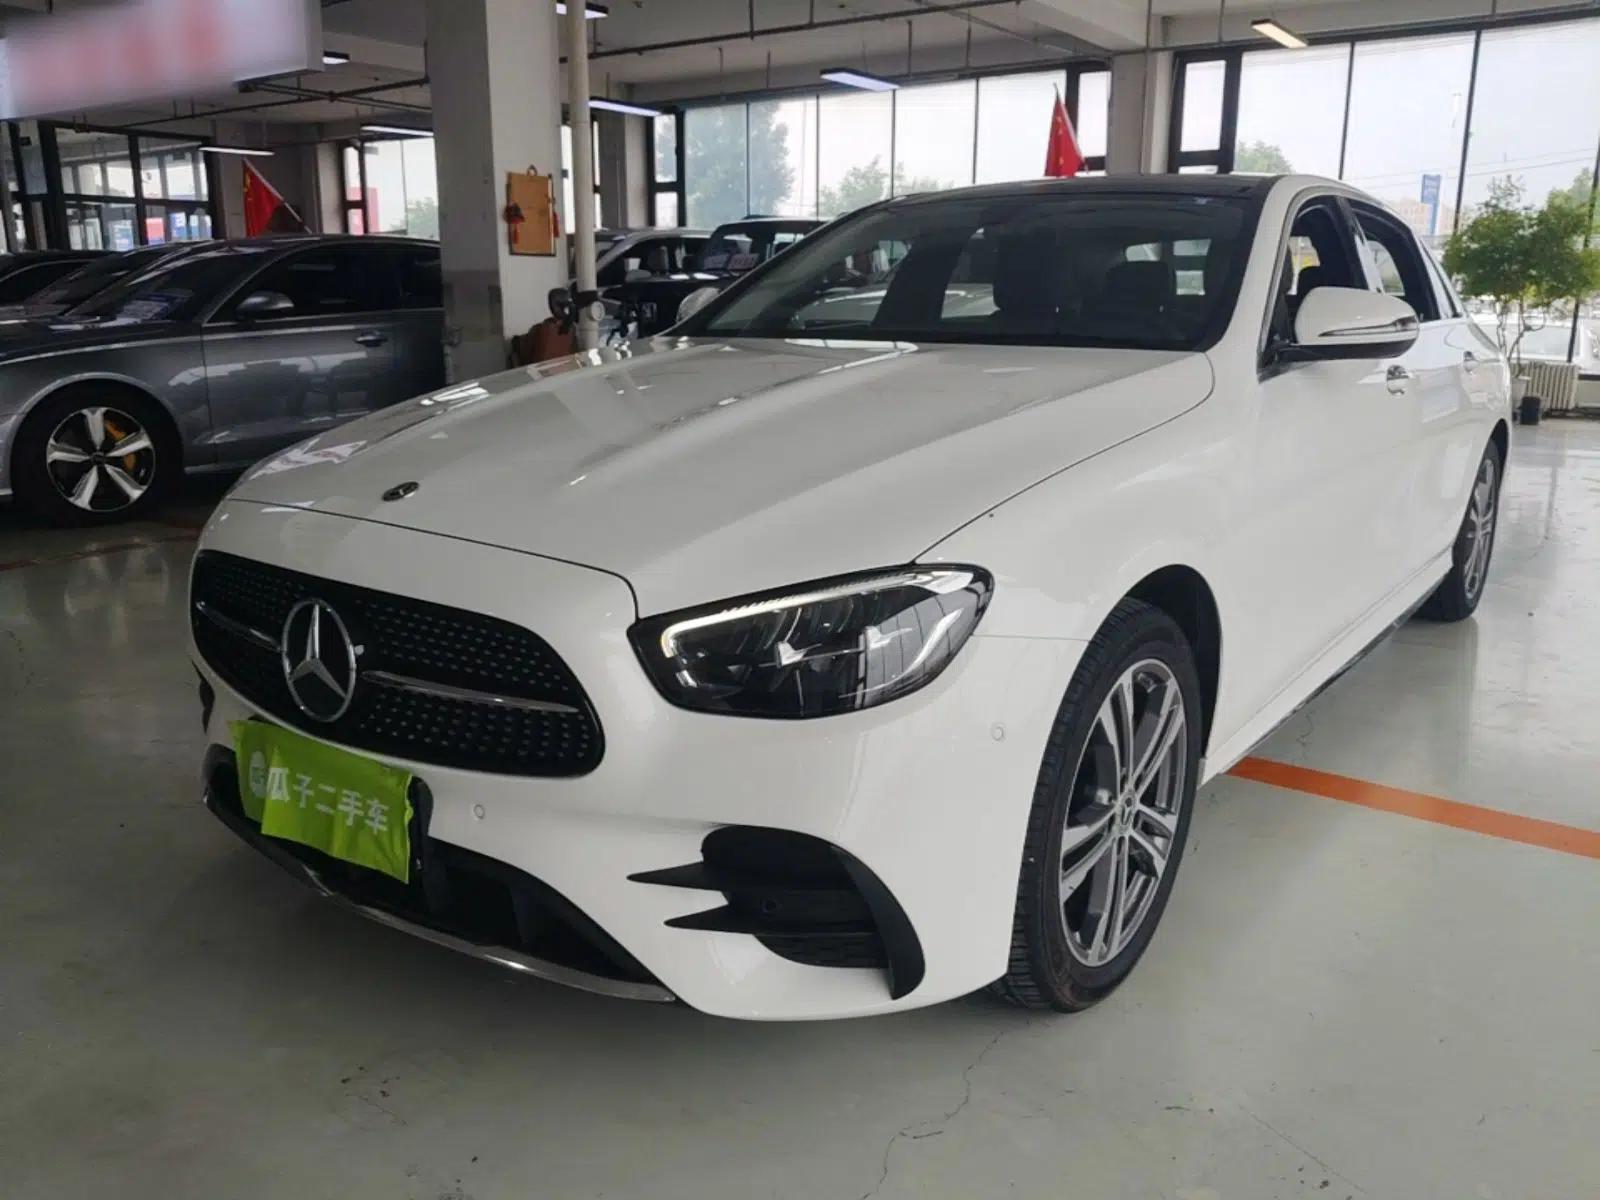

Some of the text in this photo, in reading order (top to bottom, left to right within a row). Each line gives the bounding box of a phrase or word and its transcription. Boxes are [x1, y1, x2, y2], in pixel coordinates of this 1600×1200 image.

[266, 767, 390, 835] 瓜子二手车
